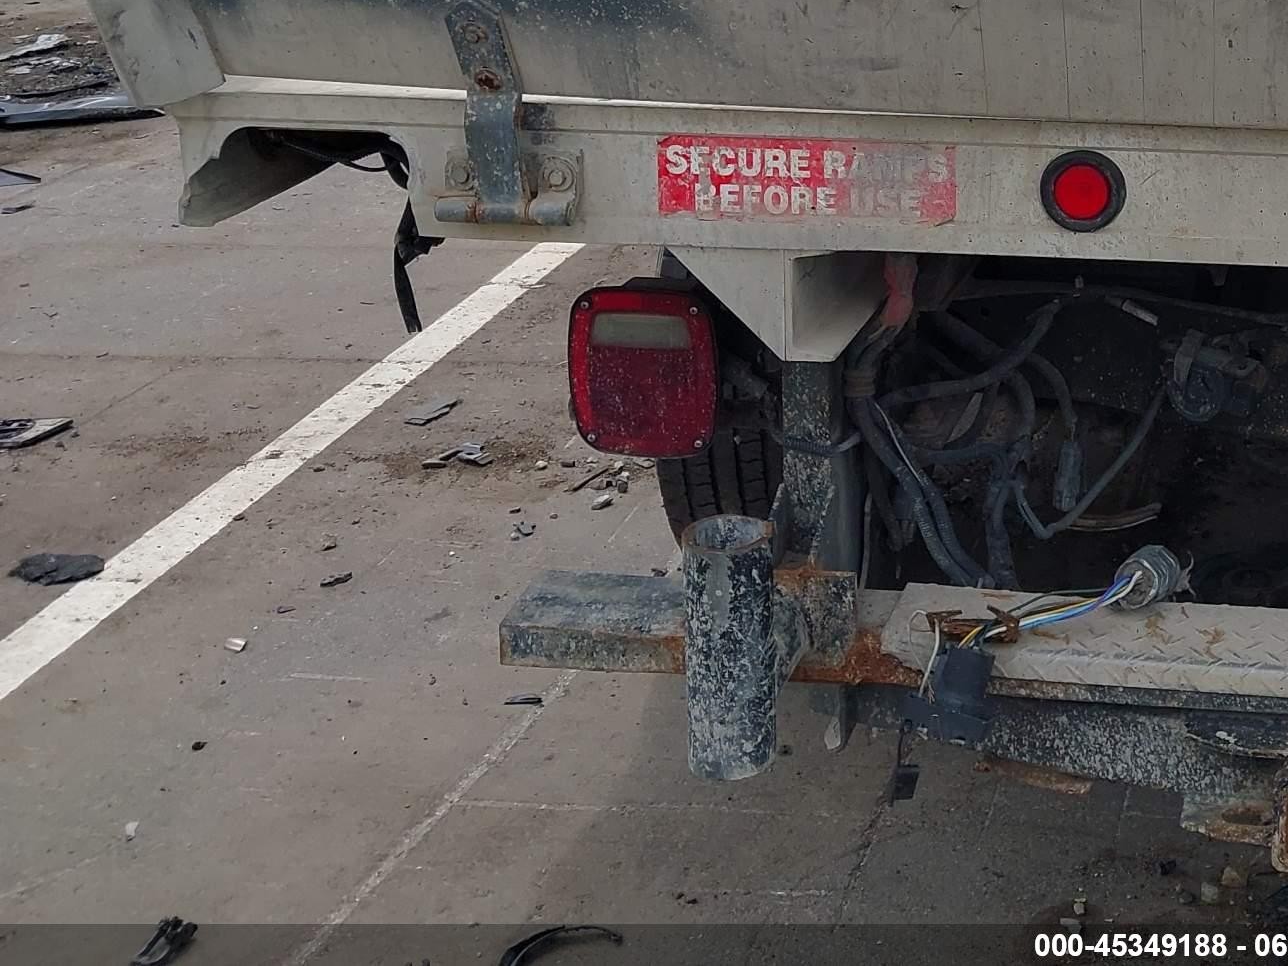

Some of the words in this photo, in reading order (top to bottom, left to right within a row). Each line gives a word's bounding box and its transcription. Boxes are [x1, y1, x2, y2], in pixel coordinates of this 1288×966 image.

[665, 145, 811, 178] SECURE
[693, 184, 837, 215] BEFORE
[848, 188, 922, 216] USE
